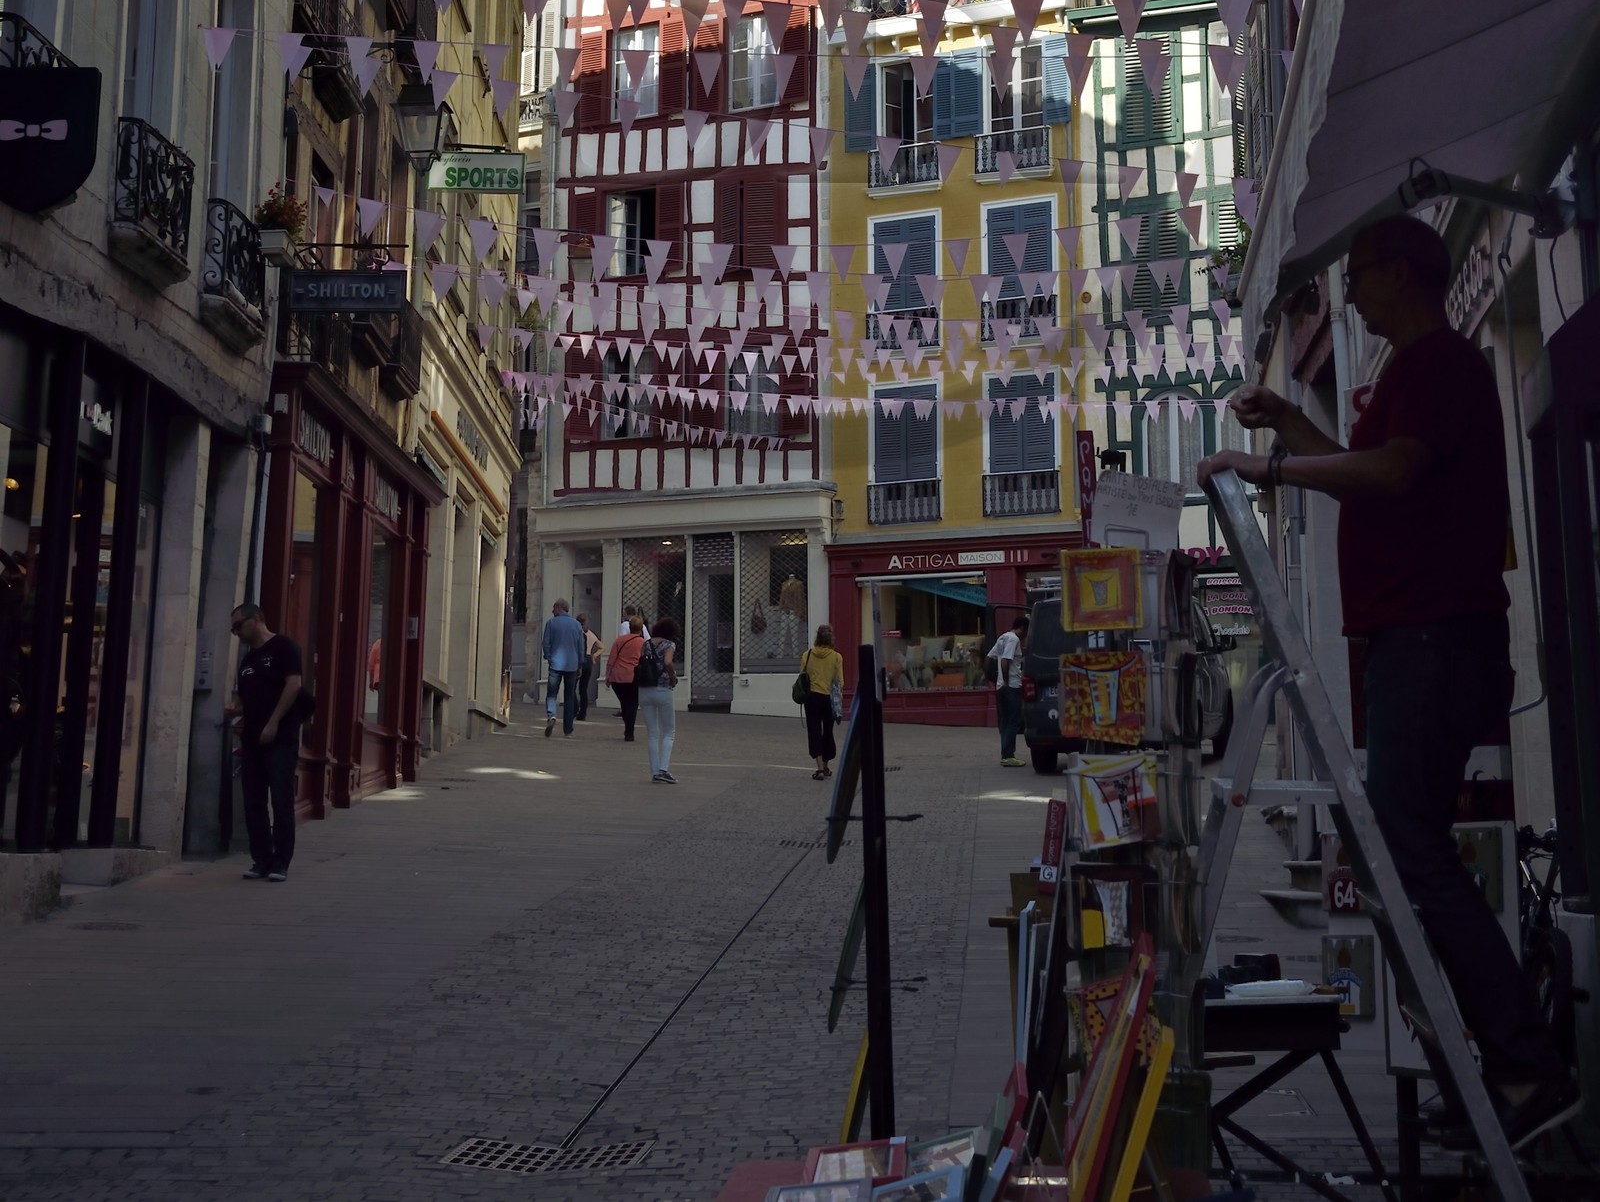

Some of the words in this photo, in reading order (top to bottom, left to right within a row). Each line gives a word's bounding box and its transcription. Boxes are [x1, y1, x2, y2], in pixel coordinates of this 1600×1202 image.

[444, 166, 519, 188] SPORTS
[308, 283, 385, 298] SHILTON
[300, 409, 331, 468] SHILTON
[1100, 471, 1129, 486] CARTE
[1133, 474, 1168, 493] POSTALE
[888, 553, 955, 570] ARTIGA
[959, 552, 1002, 563] MAISON
[1180, 545, 1224, 566] DY
[1207, 593, 1219, 602] LA
[1211, 605, 1254, 615] BONBON
[1334, 880, 1356, 909] 64
